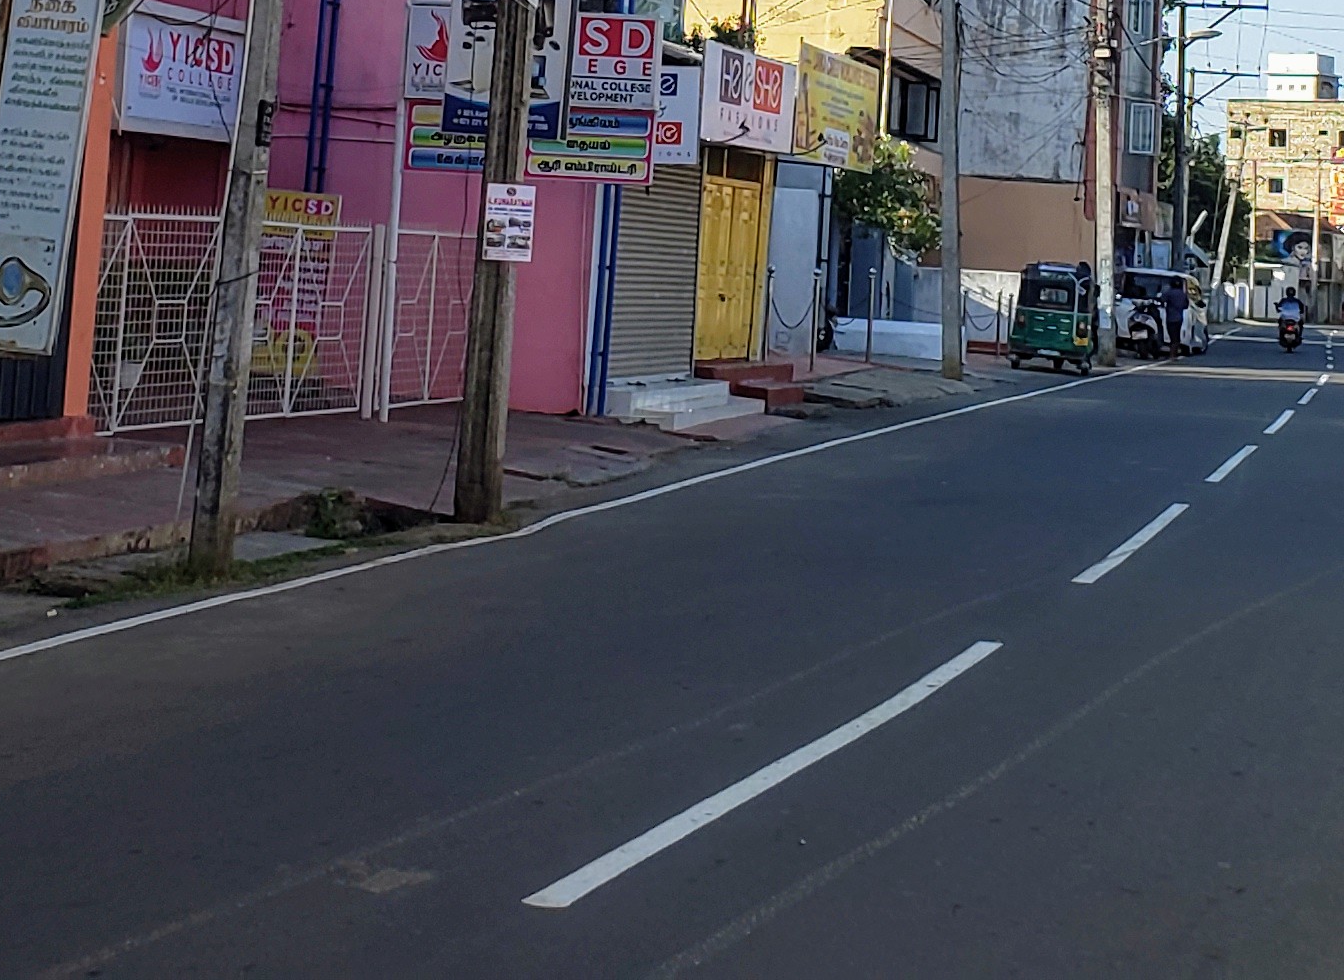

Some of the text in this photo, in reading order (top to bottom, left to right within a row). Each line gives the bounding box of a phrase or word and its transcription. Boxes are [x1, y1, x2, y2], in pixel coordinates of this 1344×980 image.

[412, 62, 443, 76] YIC
[601, 81, 651, 94] COLLEGE
[269, 195, 334, 216] YICSD
